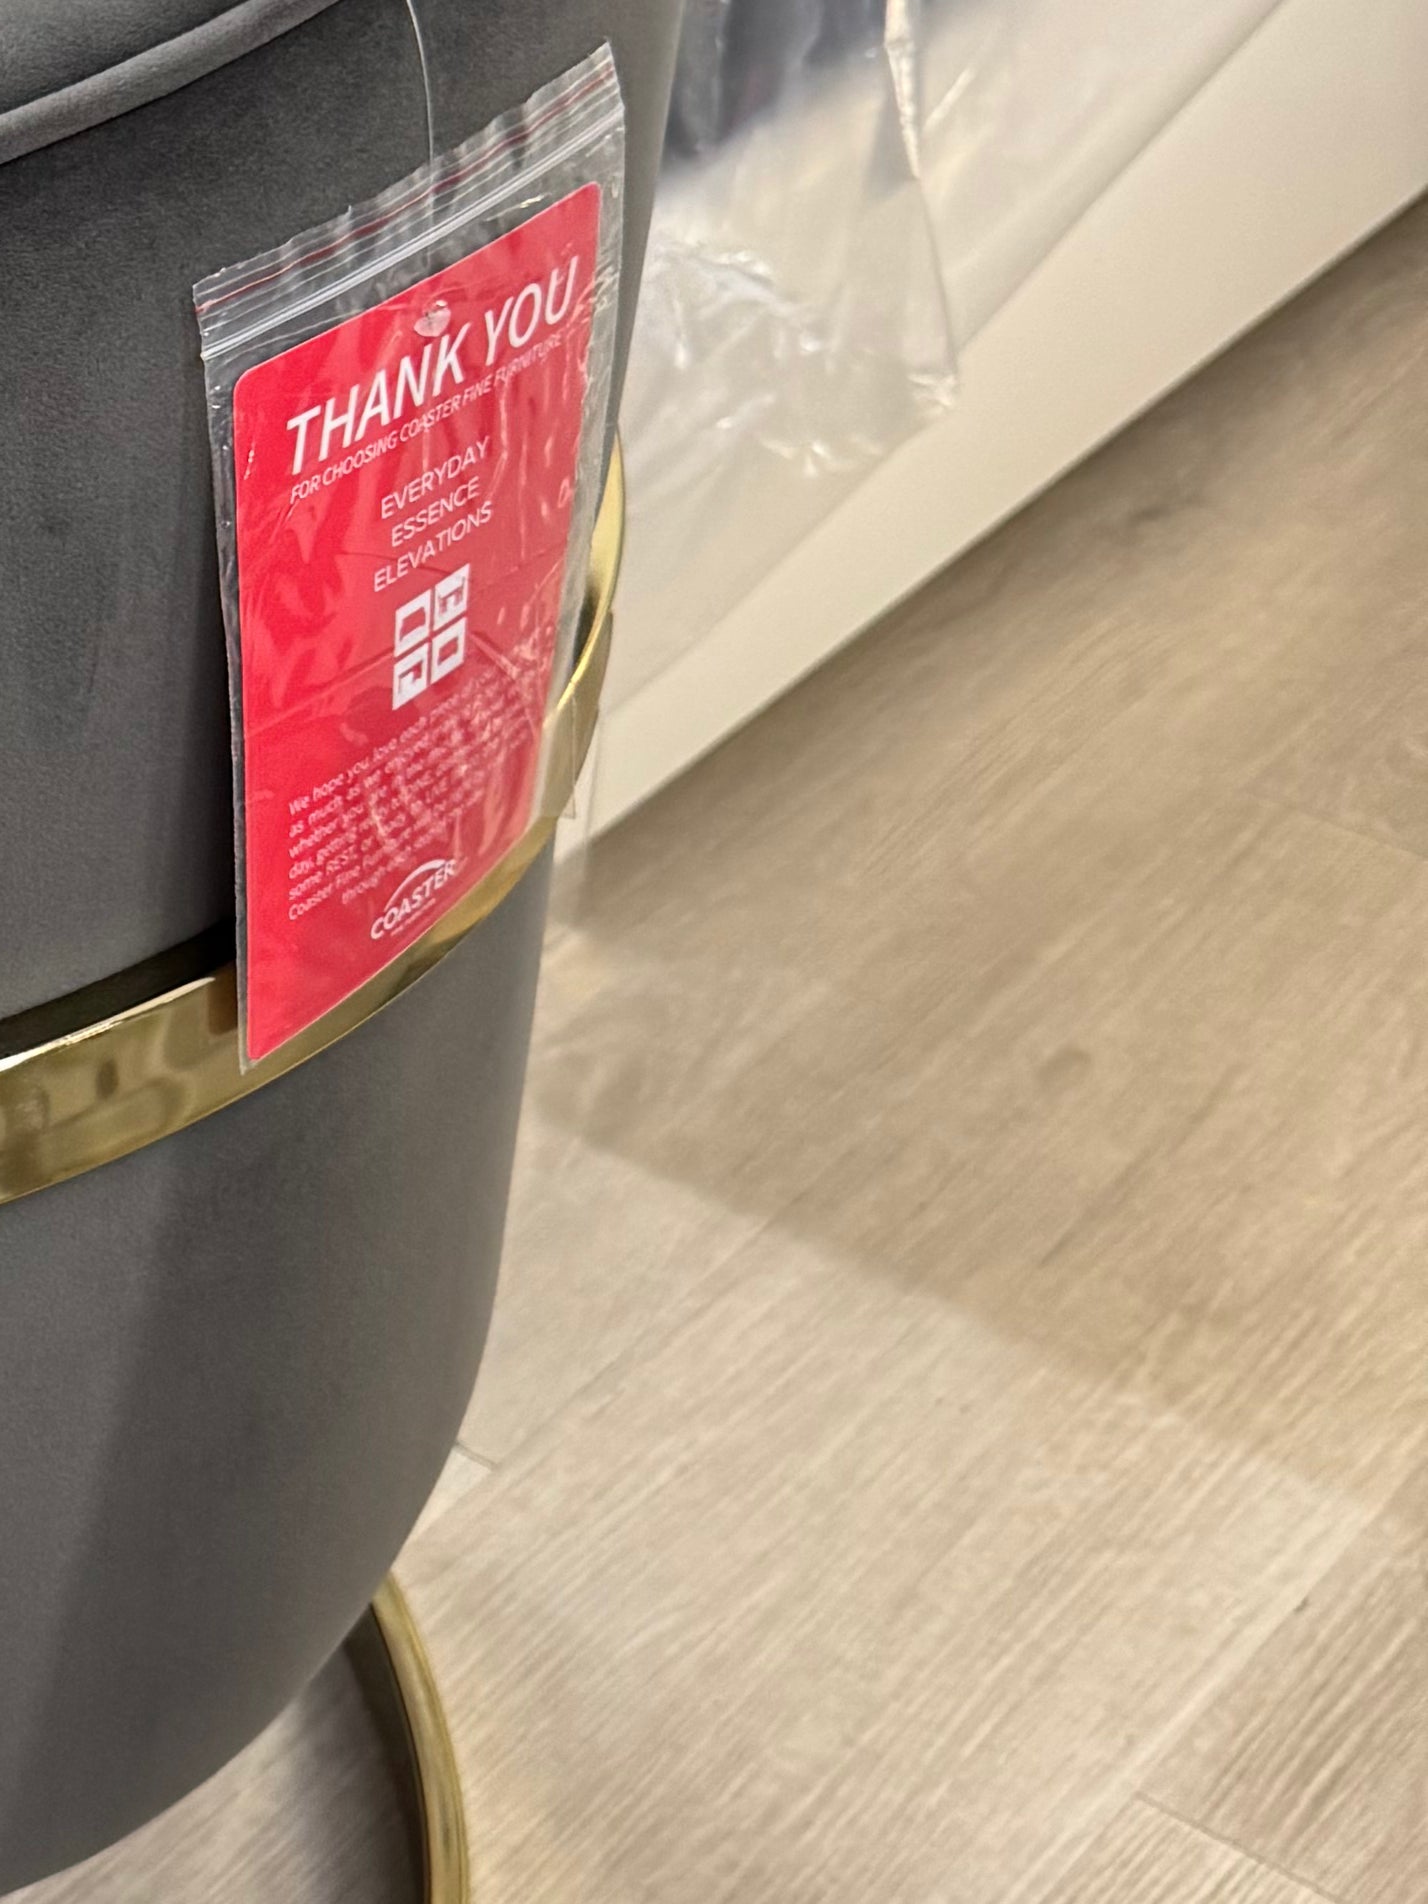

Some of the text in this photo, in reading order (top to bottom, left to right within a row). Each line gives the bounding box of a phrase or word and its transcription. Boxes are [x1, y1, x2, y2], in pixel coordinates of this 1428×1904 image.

[286, 256, 578, 476] THANK YOU
[289, 333, 562, 504] FOR CHOOSING COASTER FINE FURNITURE
[381, 435, 490, 519] EVERYDAY
[392, 476, 480, 547] ESSENCE
[374, 500, 492, 592] ELEVATIONS
[289, 796, 310, 815] We
[312, 772, 345, 802] hope
[346, 756, 369, 784] you
[289, 821, 304, 838] as
[308, 795, 343, 827] much
[289, 871, 323, 901] some
[289, 883, 333, 920] Coaster
[370, 859, 457, 940] COASTER
